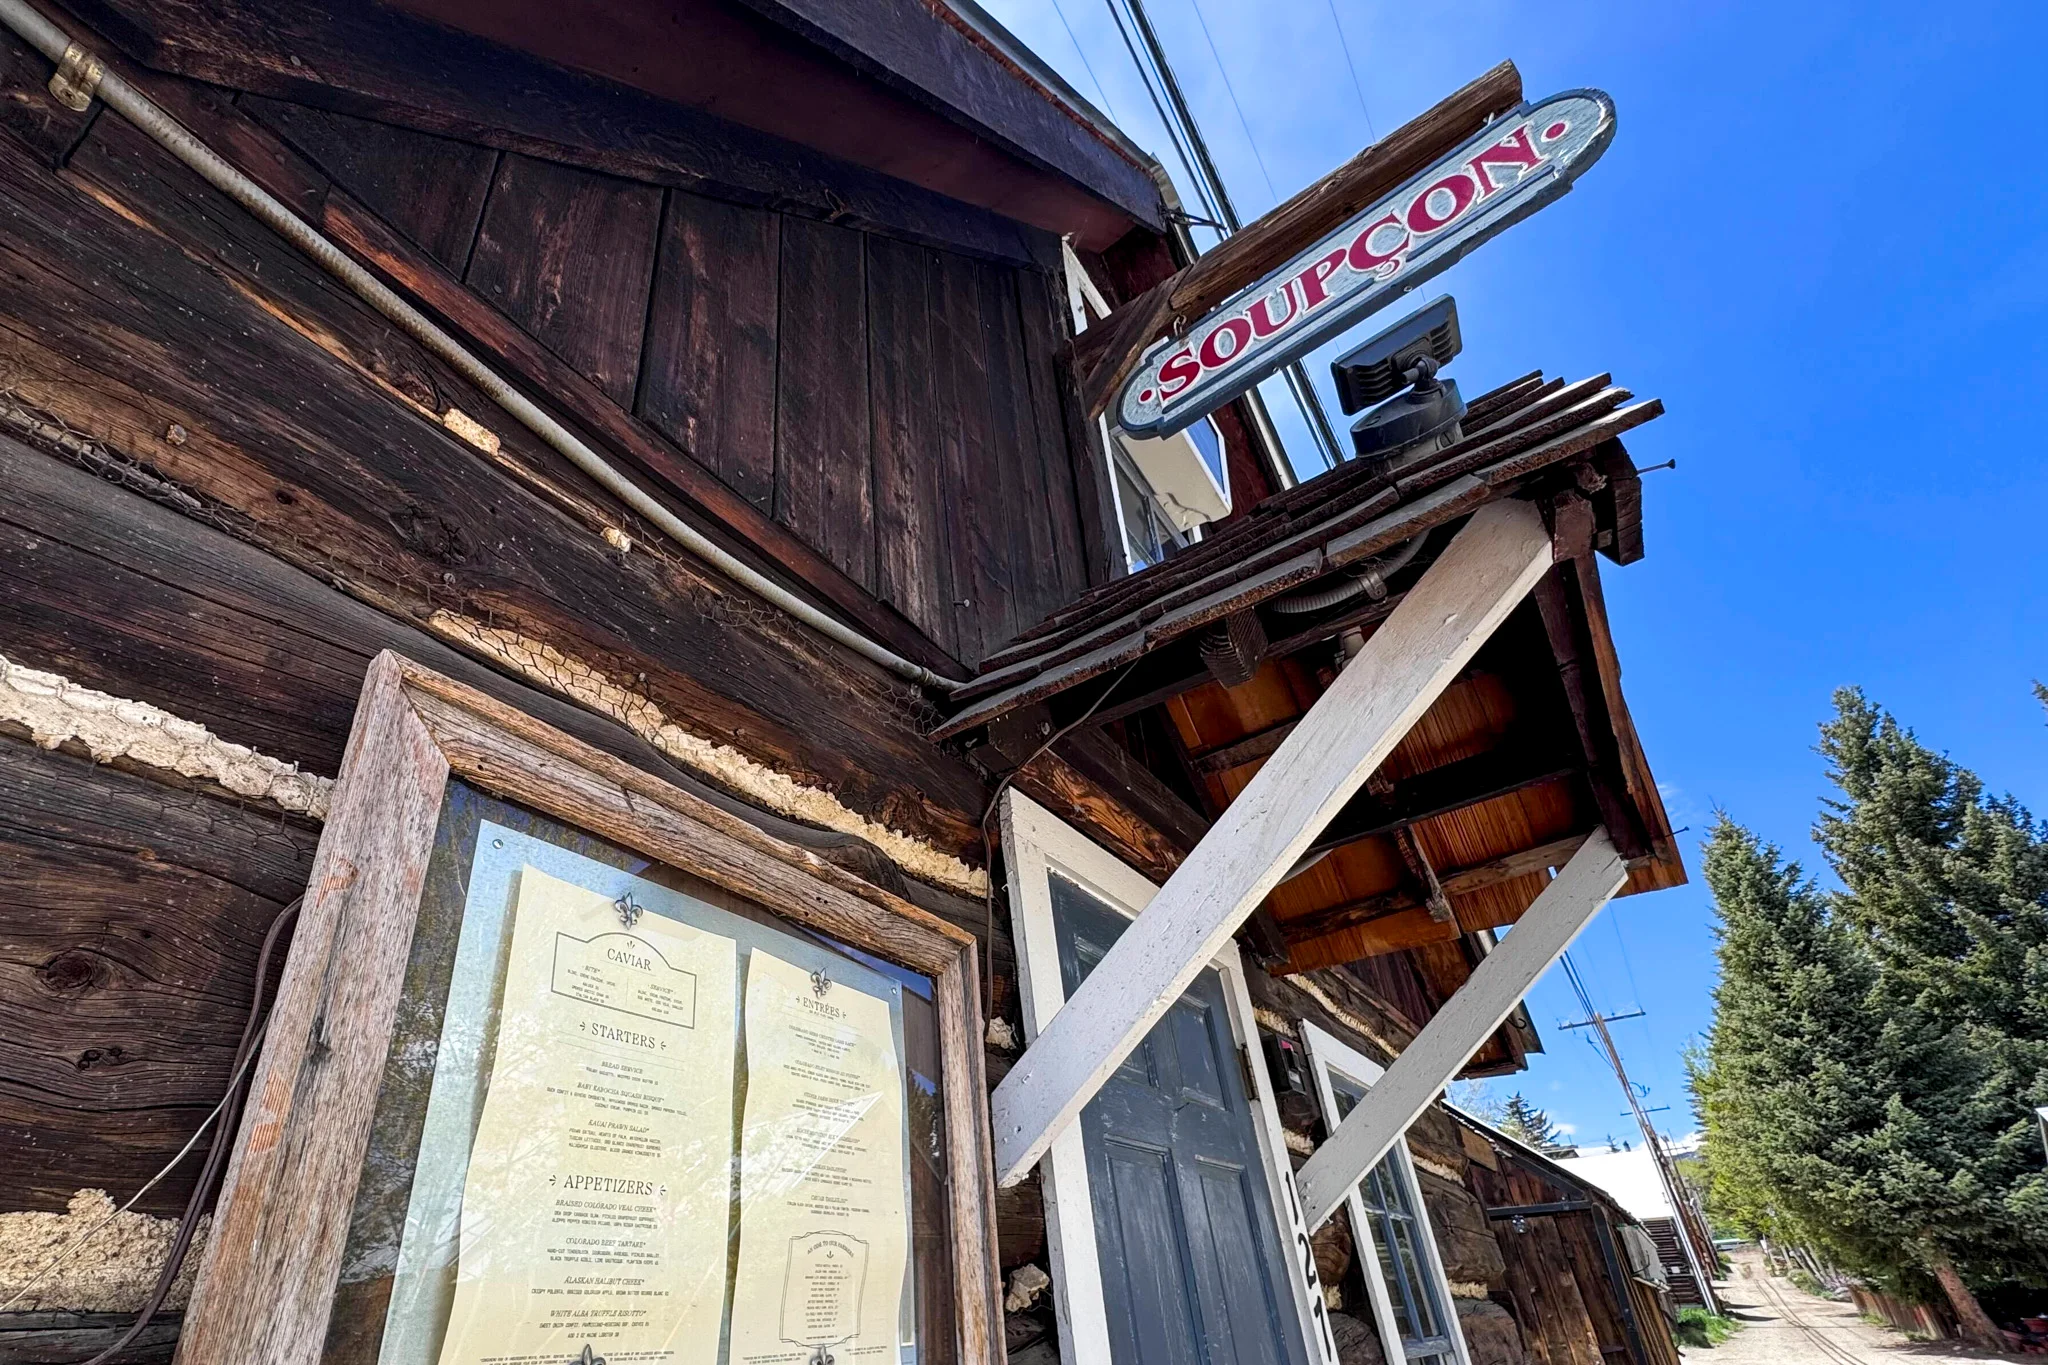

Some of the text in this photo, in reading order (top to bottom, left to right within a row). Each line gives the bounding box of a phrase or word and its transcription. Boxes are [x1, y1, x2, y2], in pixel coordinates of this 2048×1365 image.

[1156, 122, 1547, 405] SOUPÇON
[607, 947, 652, 972] CAVIAR
[803, 996, 840, 1018] ENTRÉES
[591, 1022, 656, 1049] STARTERS
[563, 1174, 653, 1196] APPETIZERS
[584, 1201, 617, 1210] COLORADO
[619, 1203, 633, 1211] VEAL
[566, 1237, 600, 1246] COLORADO
